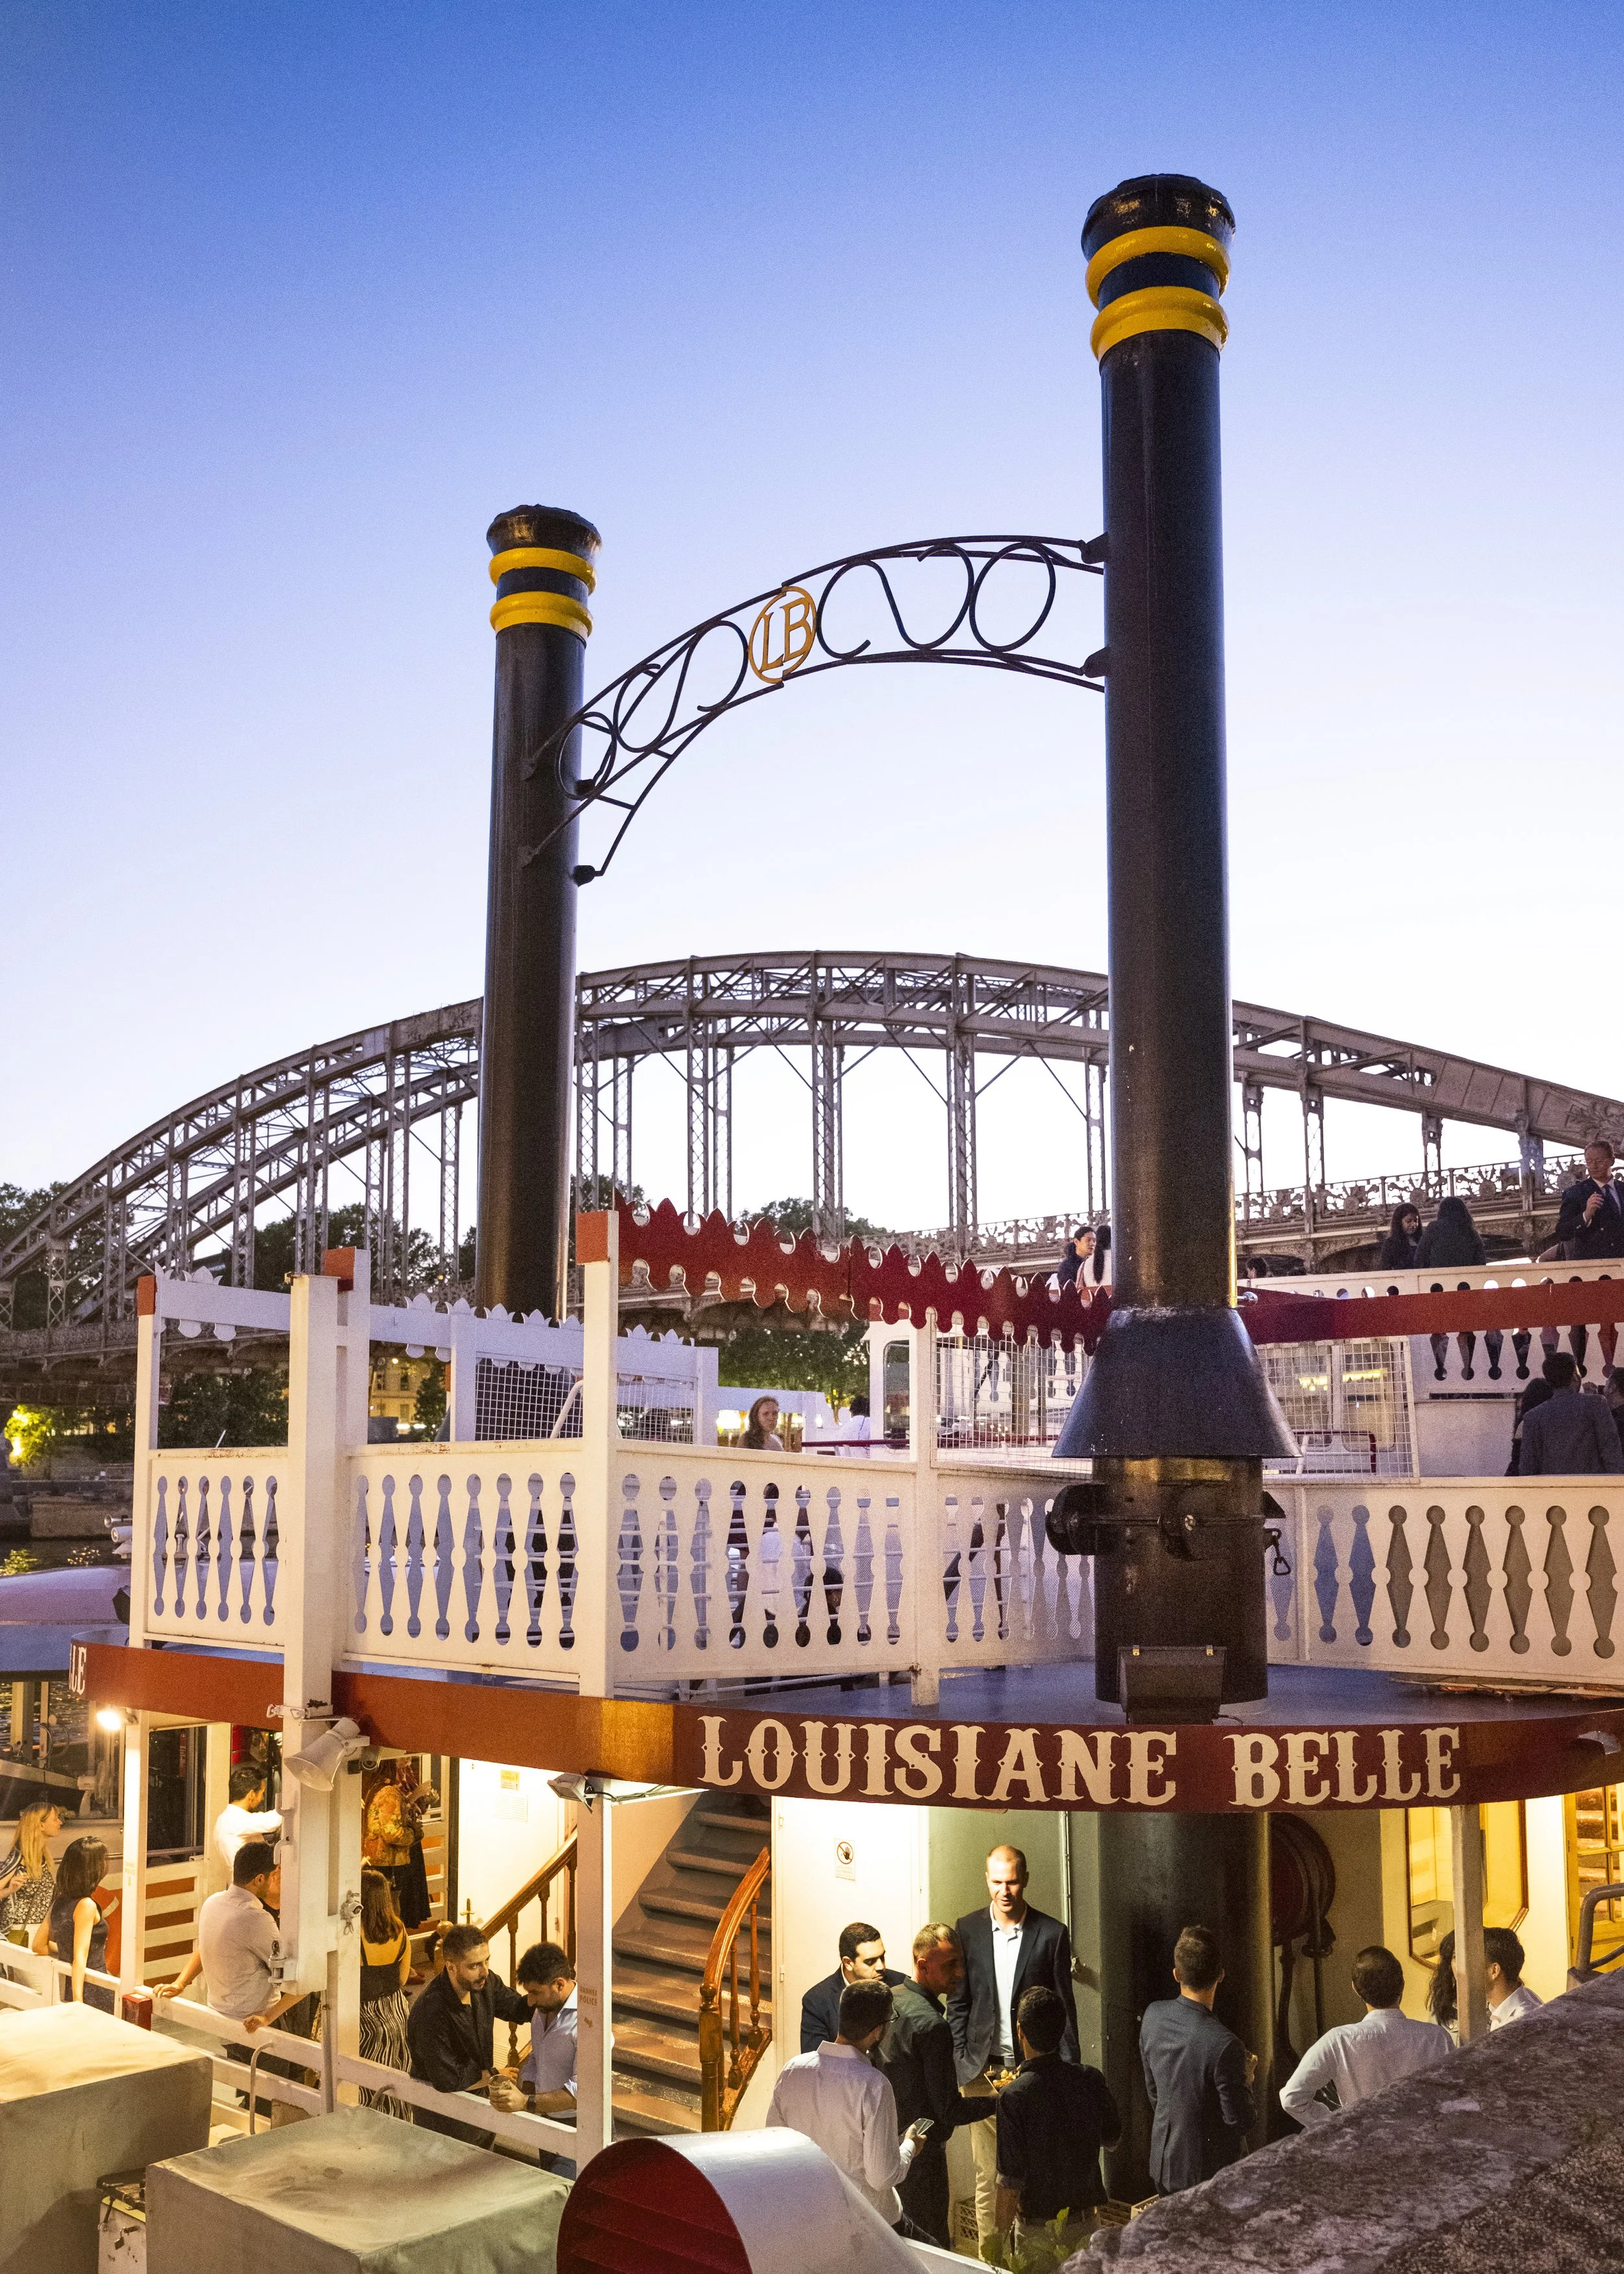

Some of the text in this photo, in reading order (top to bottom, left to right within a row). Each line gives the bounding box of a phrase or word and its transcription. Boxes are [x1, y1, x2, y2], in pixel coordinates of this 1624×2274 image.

[758, 596, 812, 674] LB
[697, 1715, 1461, 1808] LOUISIANE BELLE
[579, 1995, 598, 2006] POLICE
